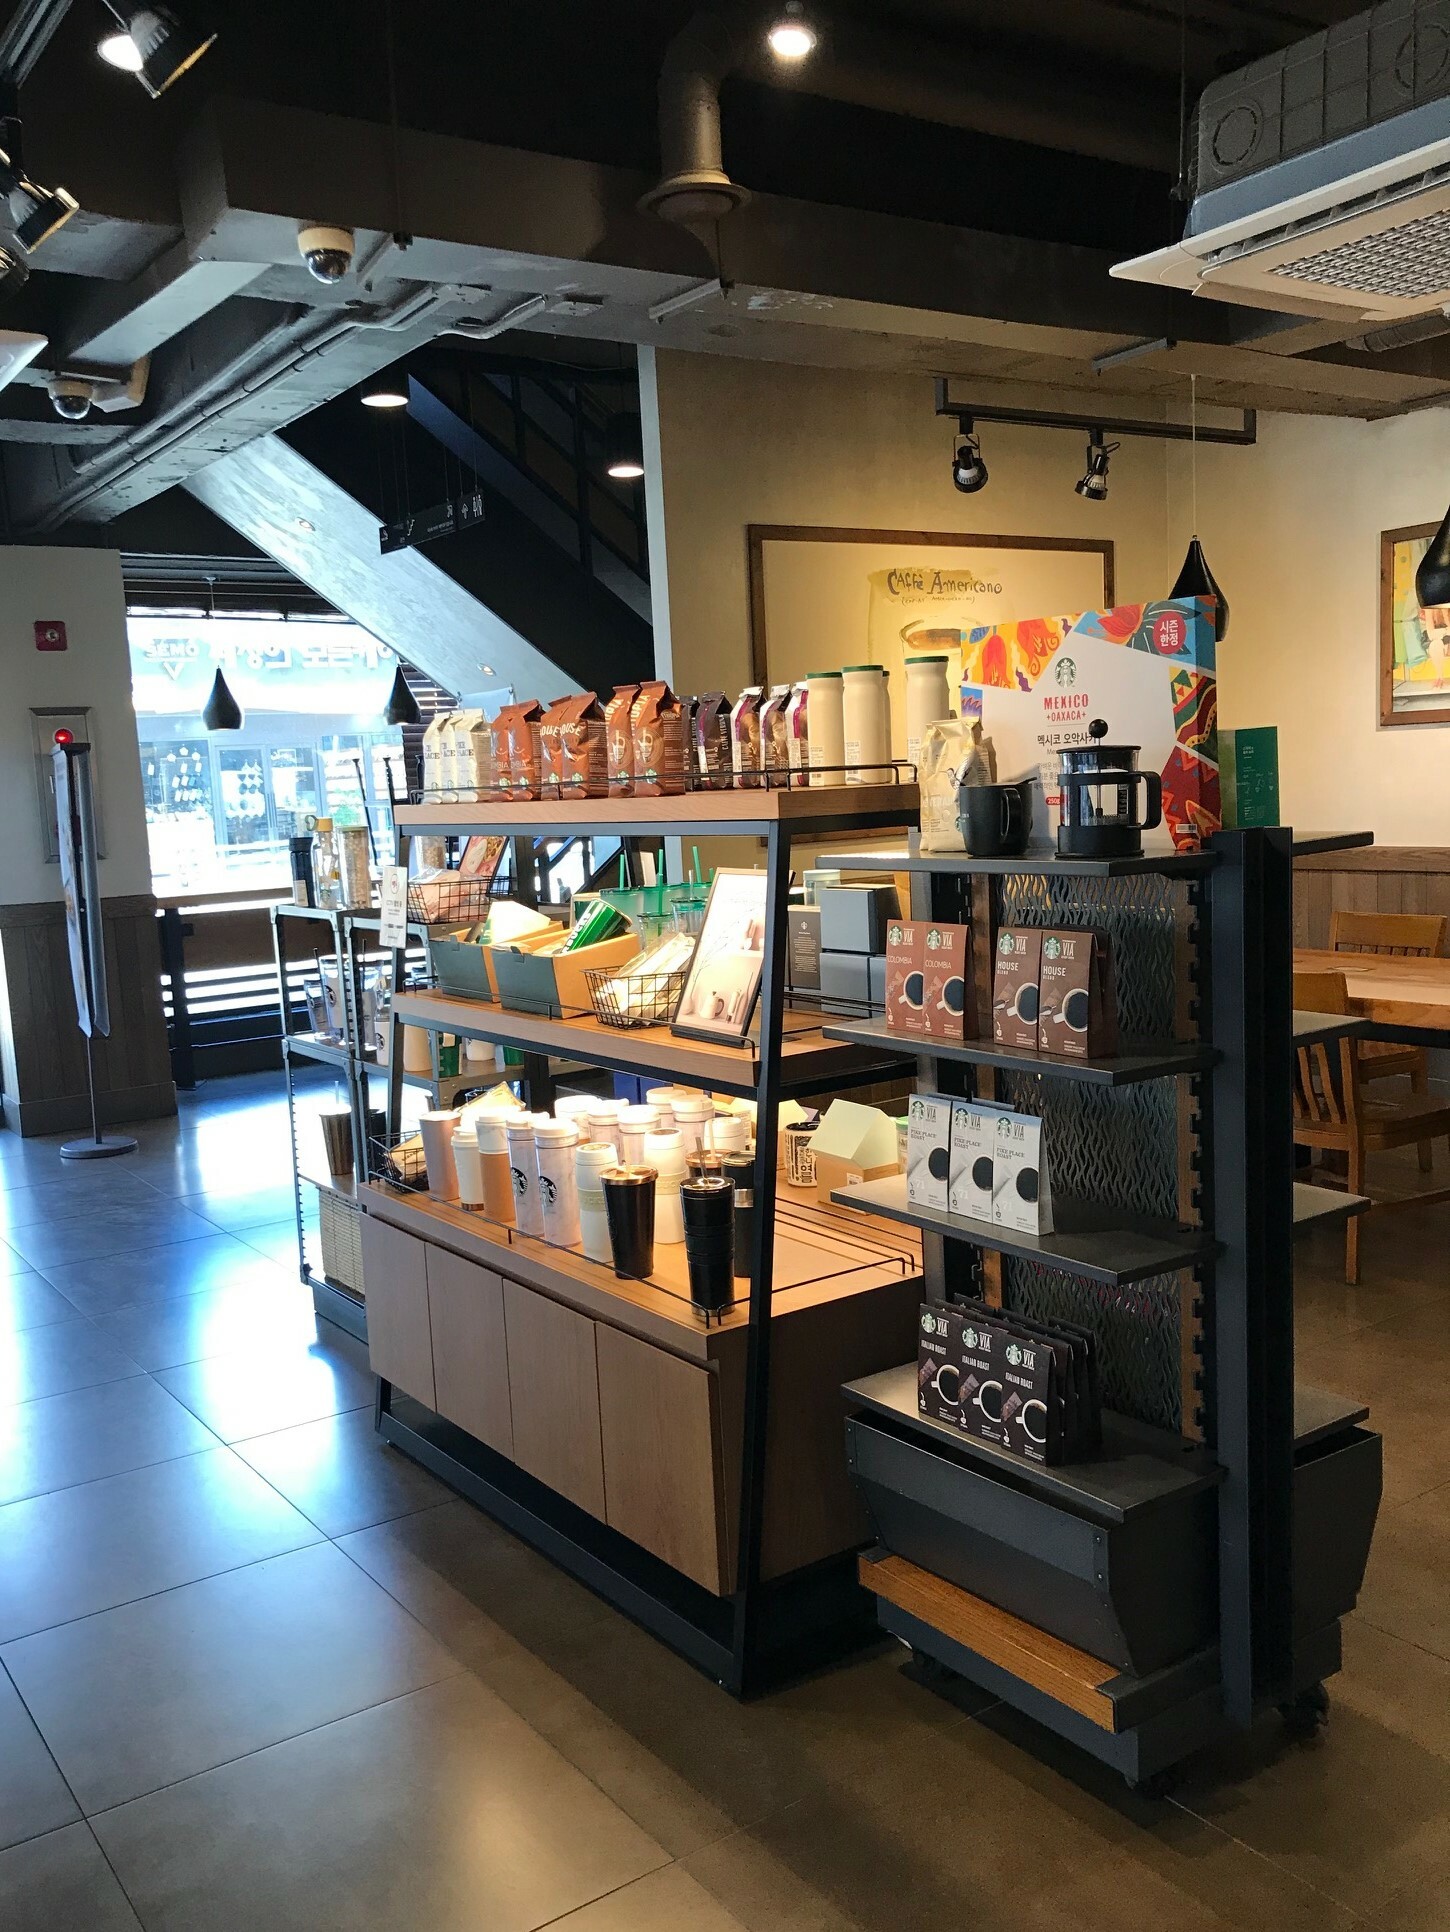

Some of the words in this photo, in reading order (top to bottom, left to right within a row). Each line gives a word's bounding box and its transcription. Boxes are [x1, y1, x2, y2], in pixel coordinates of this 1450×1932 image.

[927, 572, 1003, 594] Americano
[1160, 619, 1179, 633] 시즌
[1160, 633, 1179, 647] 한정
[1044, 694, 1089, 710] MEXICO
[1037, 734, 1061, 746] 멕시코
[903, 930, 914, 943] VIA
[942, 934, 953, 947] VIA
[1015, 938, 1026, 951] VIA
[1062, 941, 1074, 956] VIA
[887, 954, 912, 965] COLOMBIA
[925, 959, 952, 969] COLOMBIA
[997, 960, 1019, 971] HOUSE
[1042, 965, 1067, 976] HOUSE
[926, 1107, 937, 1120] VIA
[970, 1114, 981, 1128] VIA
[1013, 1123, 1025, 1137] VIA
[937, 1318, 948, 1335] VIA
[979, 1334, 991, 1351] VIA
[1023, 1351, 1034, 1368] VIA
